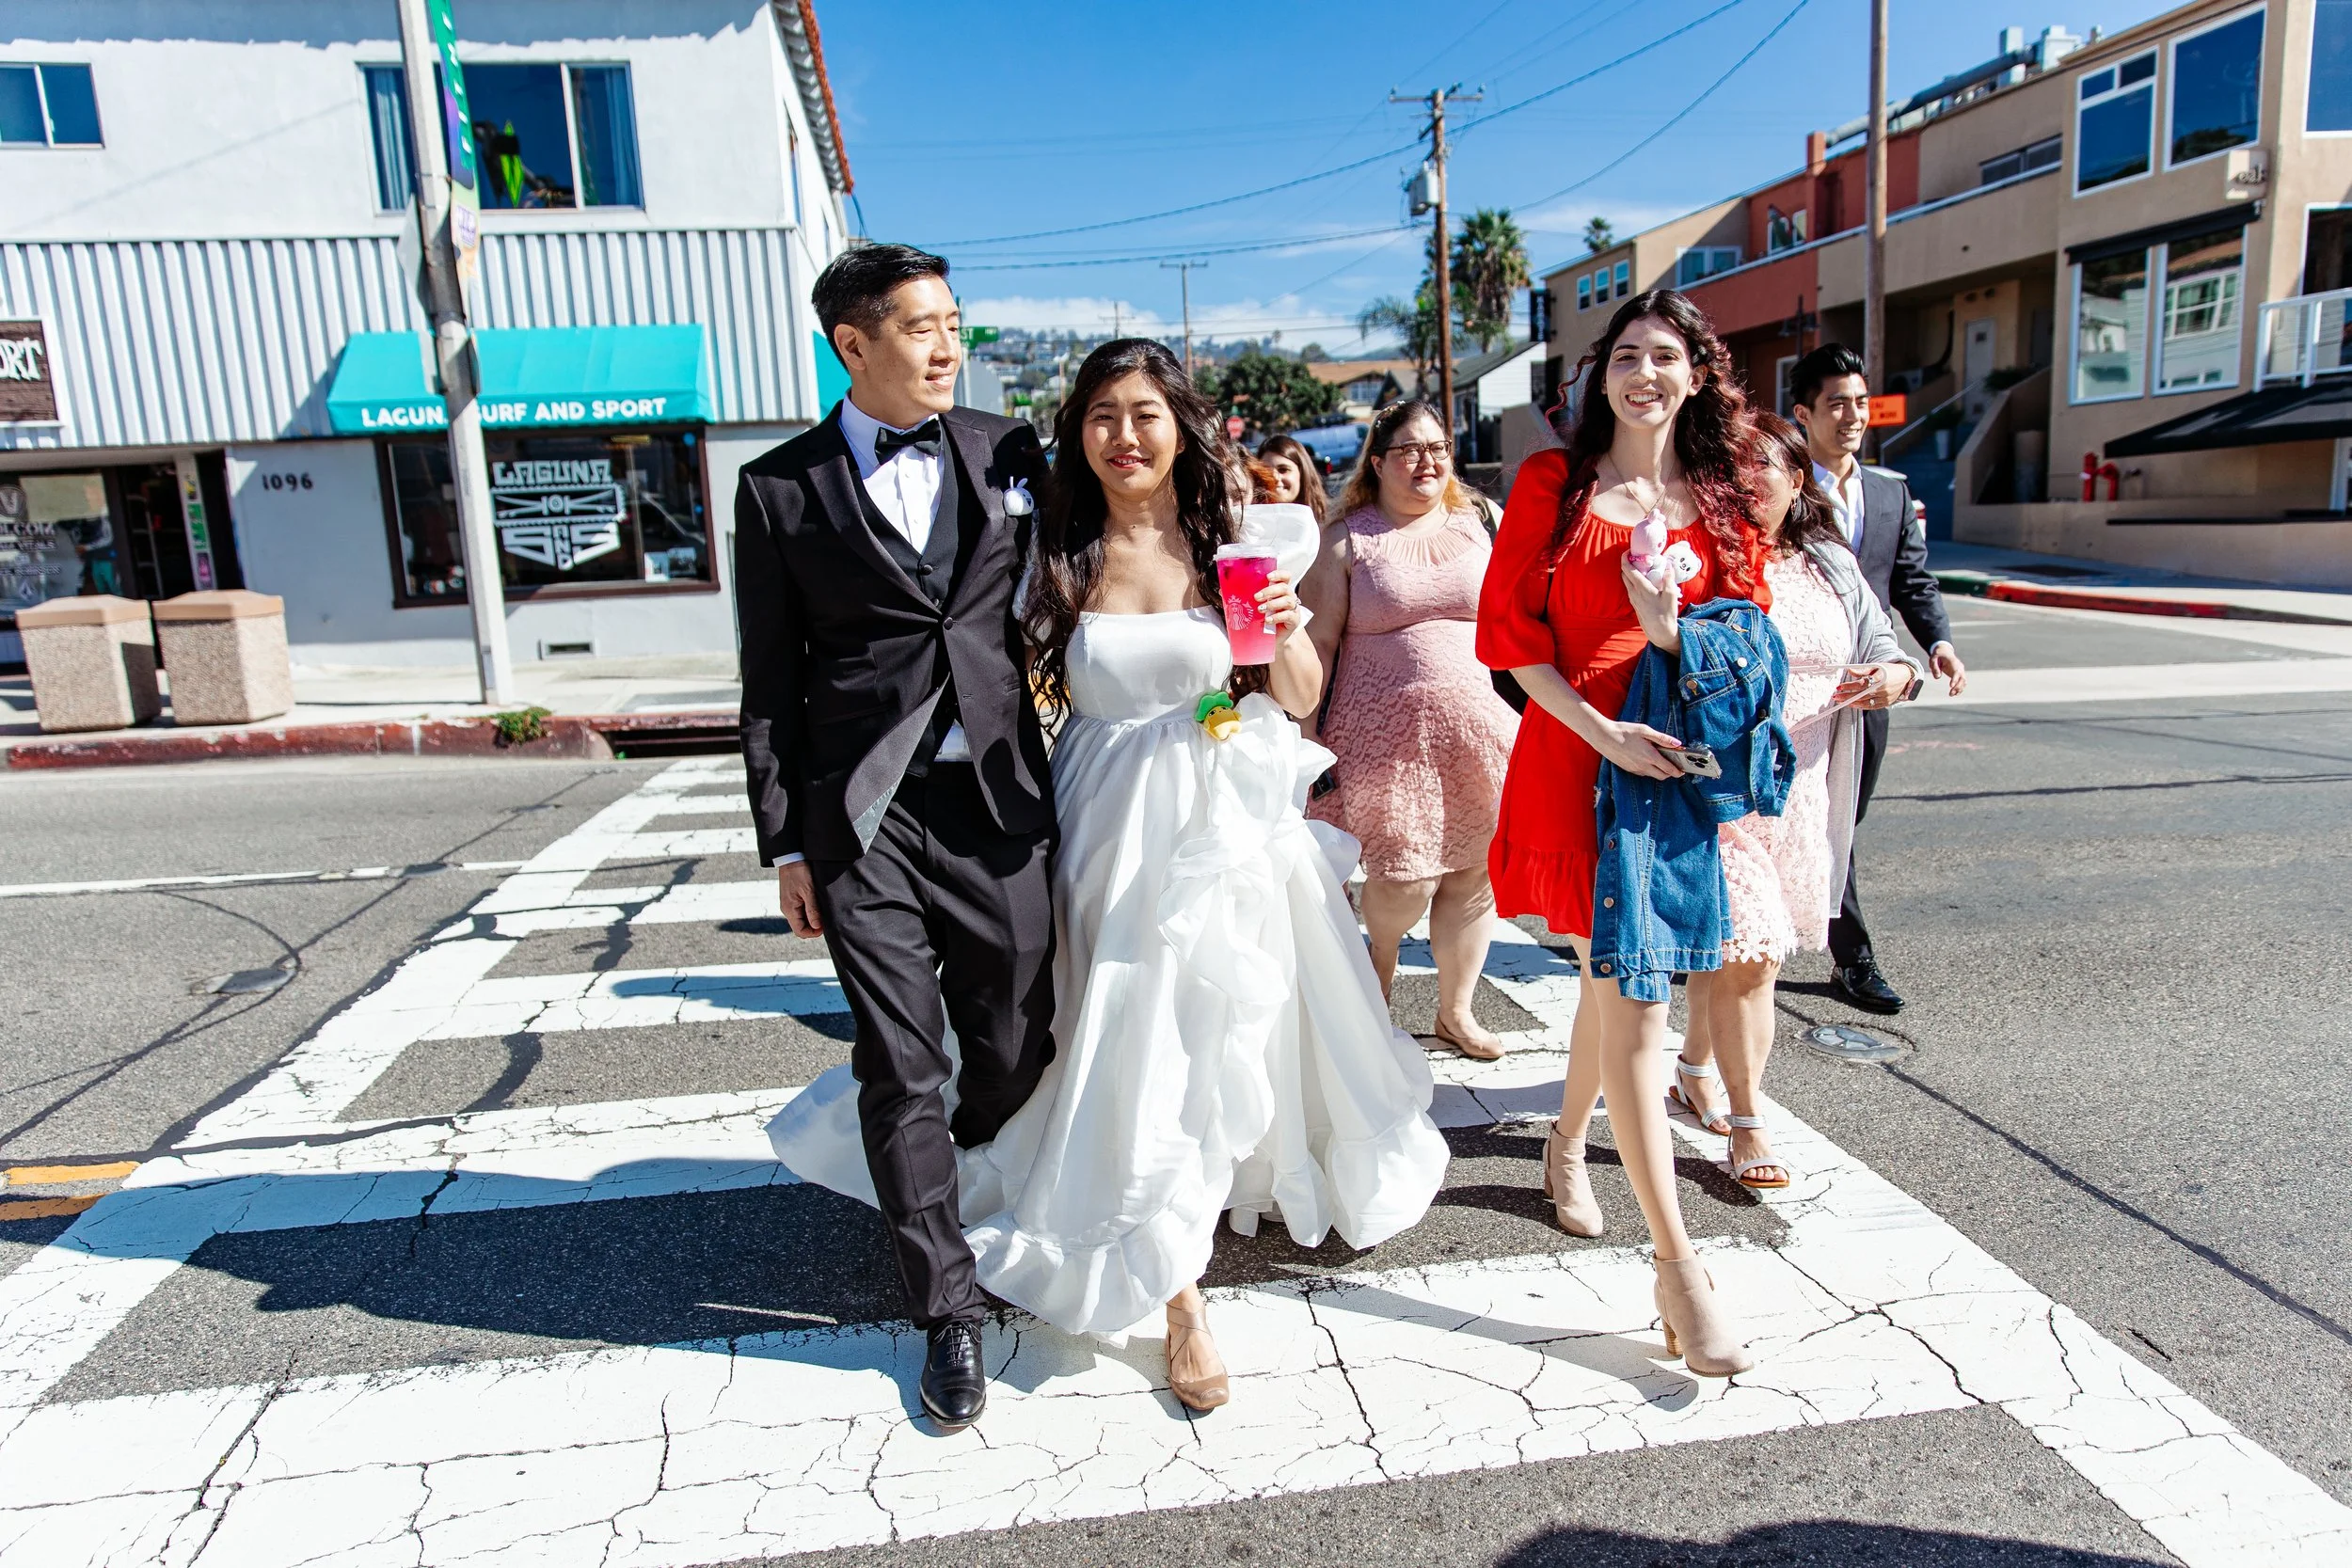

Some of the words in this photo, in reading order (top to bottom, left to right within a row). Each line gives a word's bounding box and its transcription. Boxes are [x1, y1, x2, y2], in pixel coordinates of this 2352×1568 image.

[361, 405, 449, 427] LAGUN
[534, 401, 585, 420] AND
[592, 397, 667, 420] SPORT
[262, 472, 313, 492] 1096
[492, 459, 612, 486] LAGUNA
